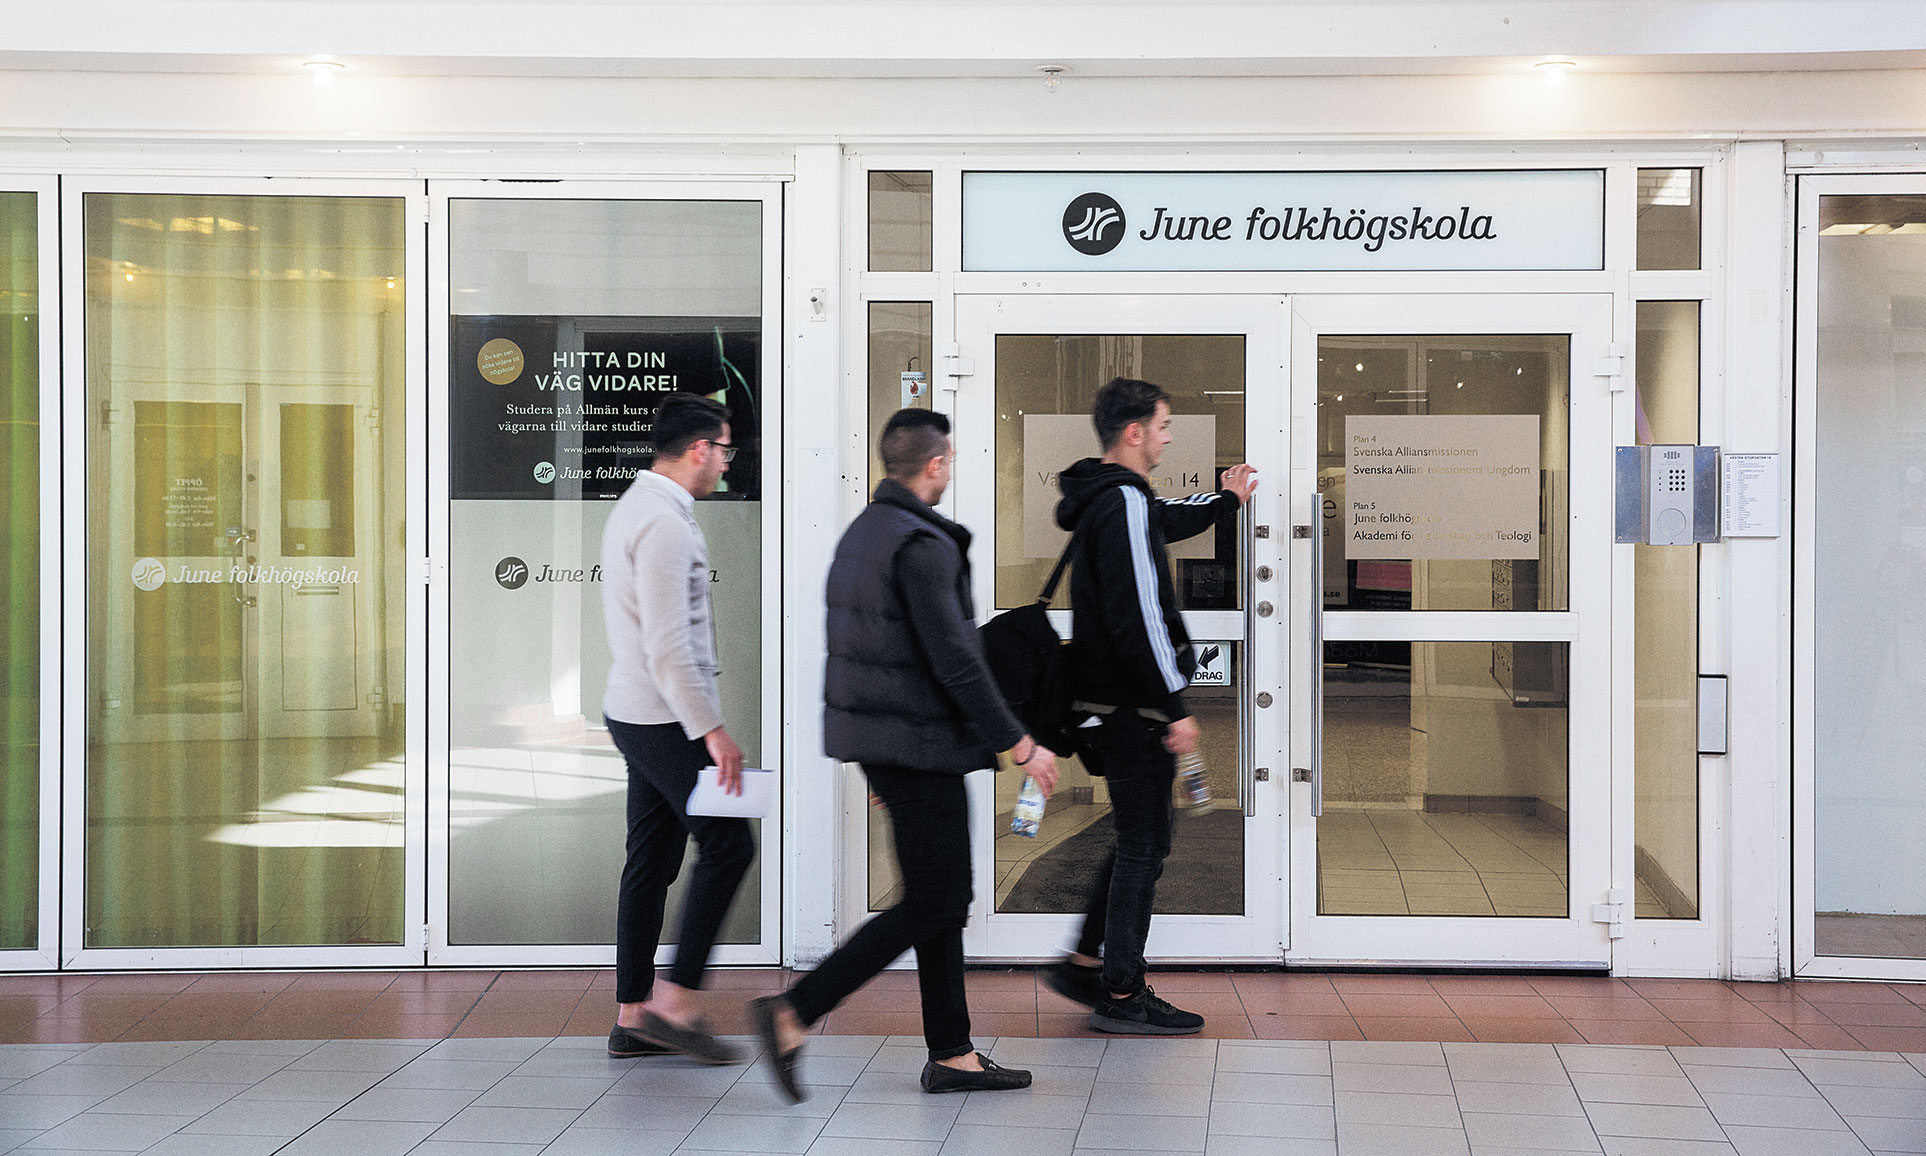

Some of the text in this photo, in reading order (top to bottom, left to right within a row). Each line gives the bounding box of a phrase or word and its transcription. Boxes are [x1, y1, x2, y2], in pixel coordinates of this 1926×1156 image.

[1139, 206, 1497, 253] June folkhögskola
[553, 351, 666, 368] HITTA DIN
[534, 370, 678, 392] VÄG VIDARE!
[506, 403, 553, 415] Studera
[557, 403, 572, 418] på
[575, 403, 619, 415] Allmän
[623, 404, 649, 415] kurs
[498, 421, 653, 435] vägarna till vidare studier
[1353, 435, 1377, 443] Plan 4
[563, 445, 658, 455] www.junefolkhogskola.
[1353, 446, 1479, 457] Svenska Alliansmissionen
[559, 466, 592, 479] June
[1353, 464, 1393, 475] Svenska
[1487, 464, 1531, 477] Ungdom
[1182, 472, 1200, 488] 14
[1353, 502, 1376, 510] Plan 5
[1354, 513, 1377, 525] June
[1353, 530, 1398, 541] Akademi
[1400, 530, 1416, 541] för
[1495, 530, 1532, 543] Teologi
[172, 565, 362, 590] June folkhögskola
[535, 564, 584, 583] June
[1194, 671, 1223, 681] DRAG
